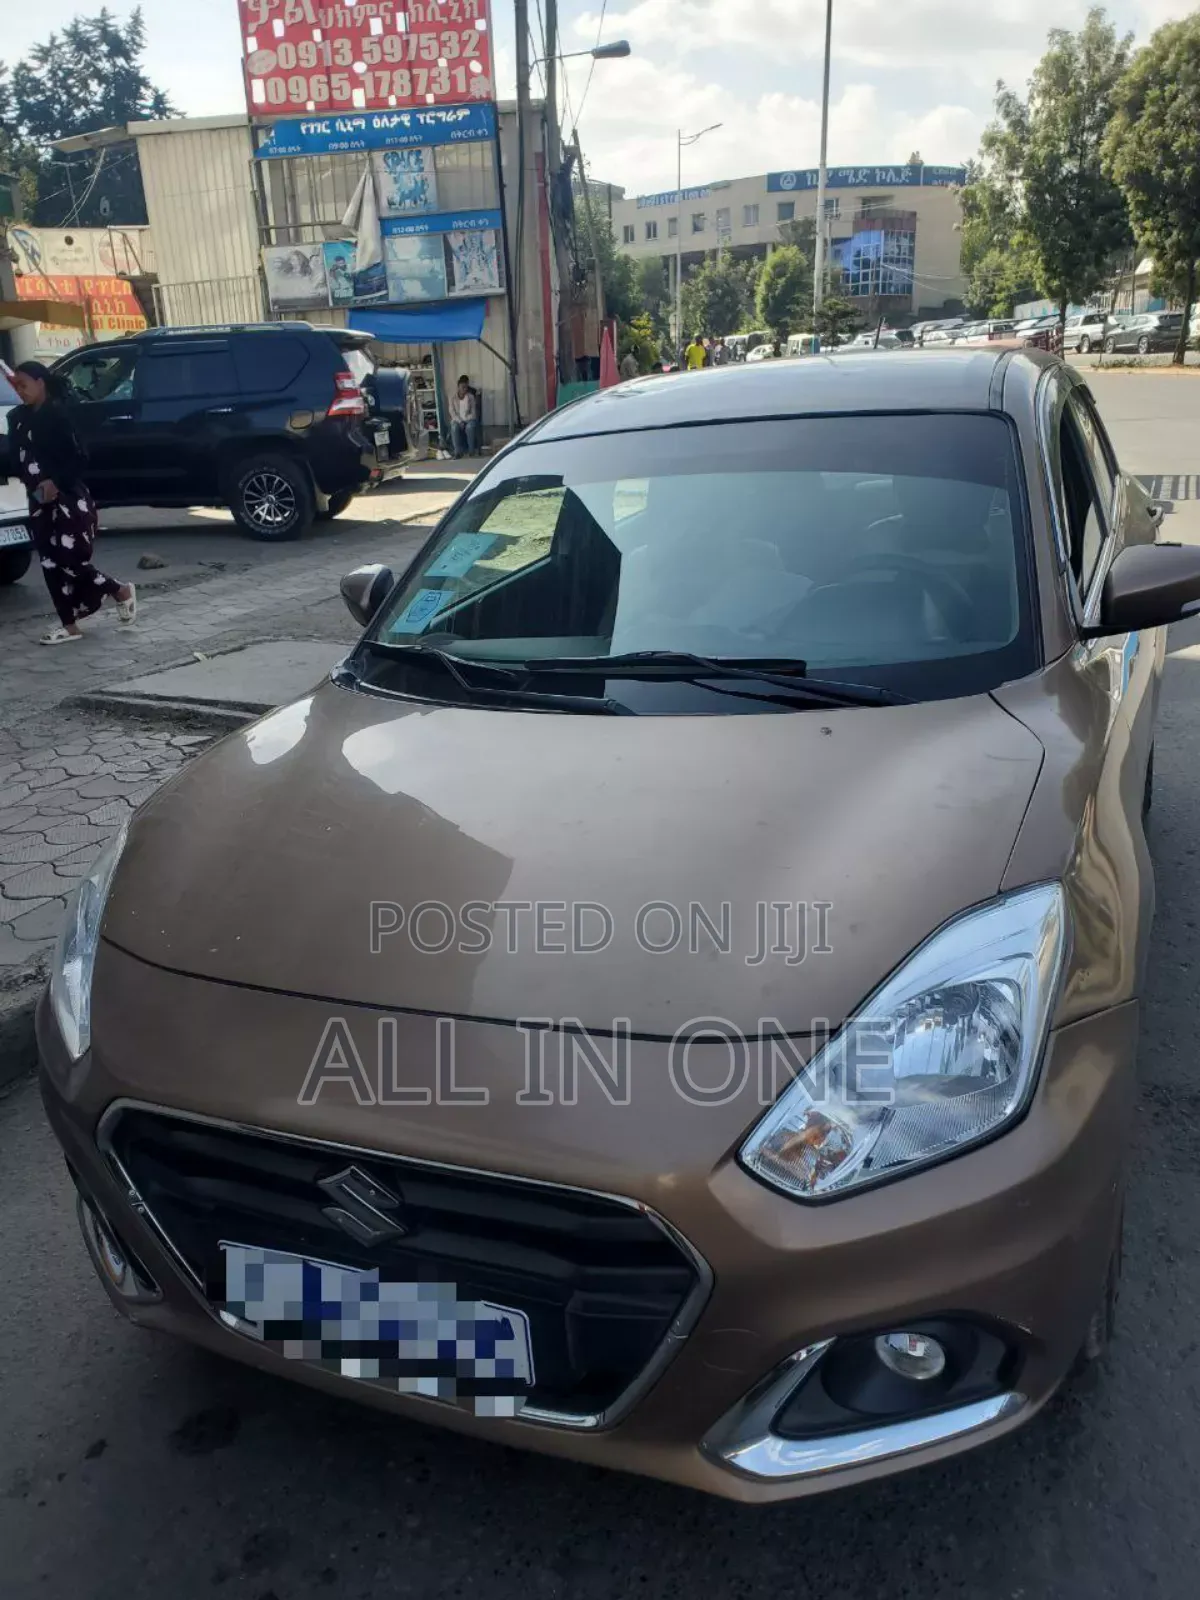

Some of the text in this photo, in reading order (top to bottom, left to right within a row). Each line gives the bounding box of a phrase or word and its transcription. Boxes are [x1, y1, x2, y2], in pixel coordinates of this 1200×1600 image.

[276, 29, 481, 70] 0913 597532
[266, 65, 466, 105] 0965 178731
[107, 317, 145, 330] Clinic
